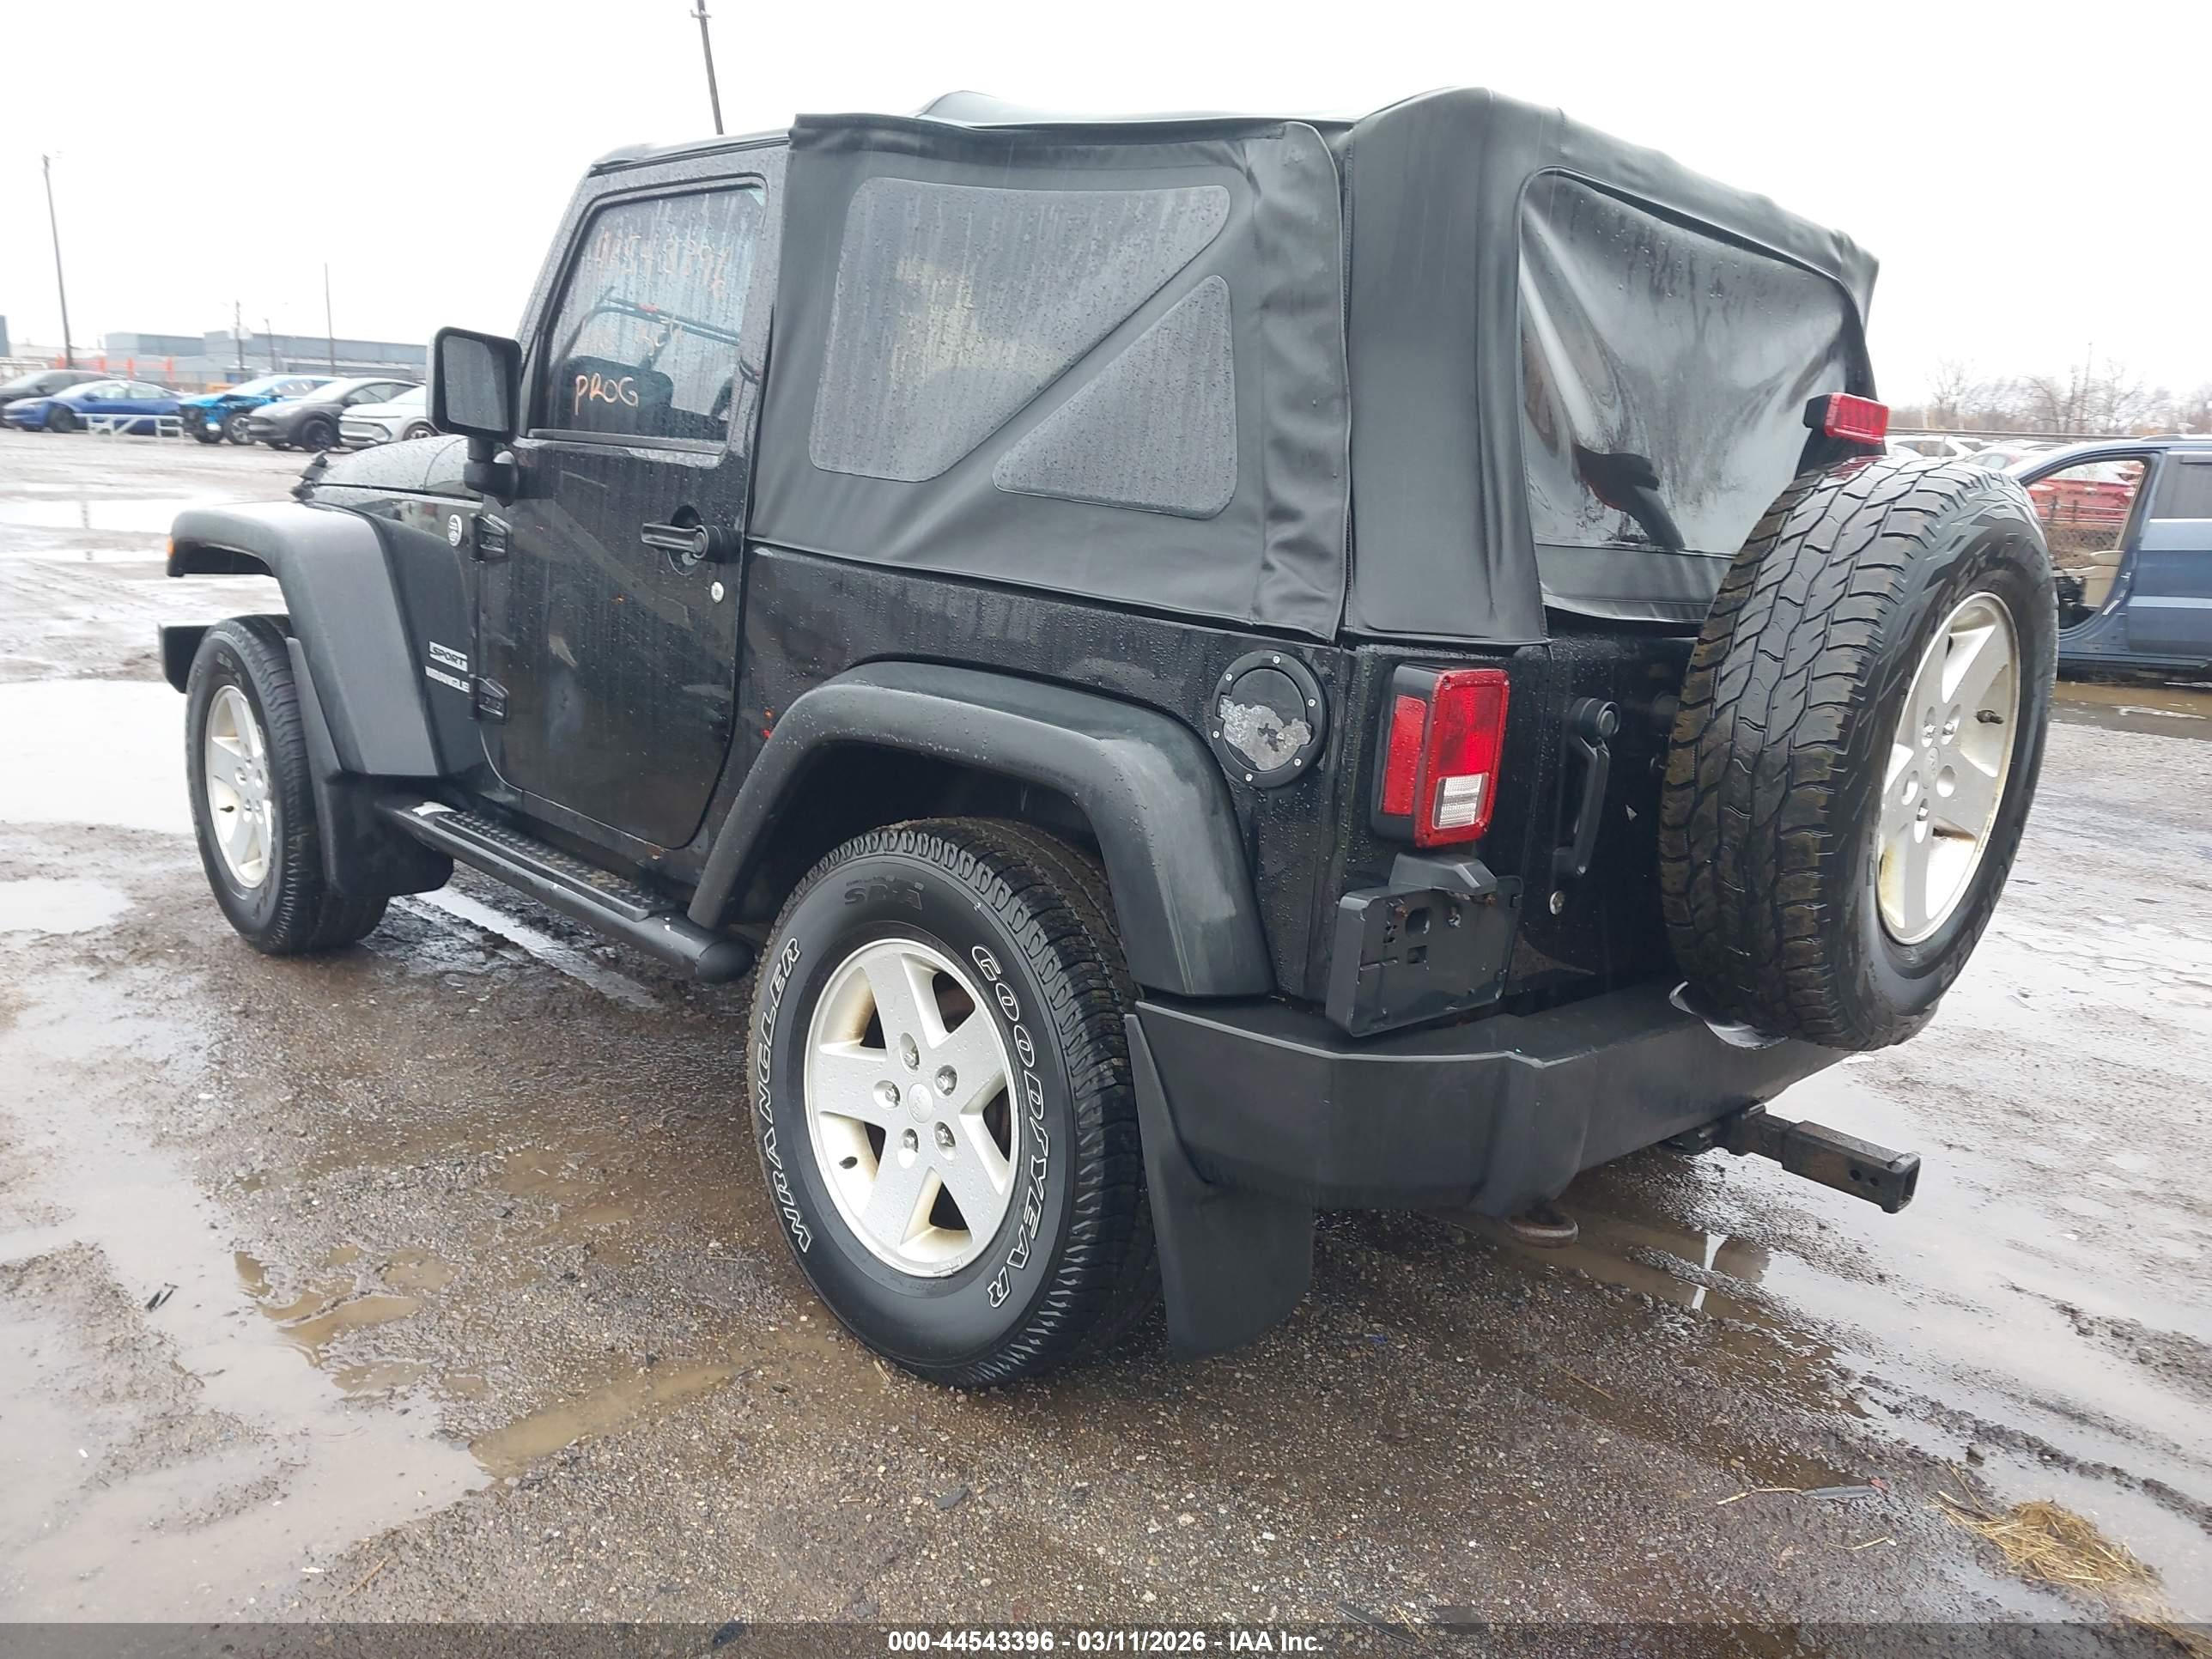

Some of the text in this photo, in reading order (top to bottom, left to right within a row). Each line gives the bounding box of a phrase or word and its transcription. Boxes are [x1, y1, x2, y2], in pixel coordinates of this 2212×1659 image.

[574, 373, 639, 416] PROG
[428, 644, 468, 669] SPORT
[757, 938, 811, 1253] WRANGLER
[971, 945, 1049, 1308] GOODYEAR
